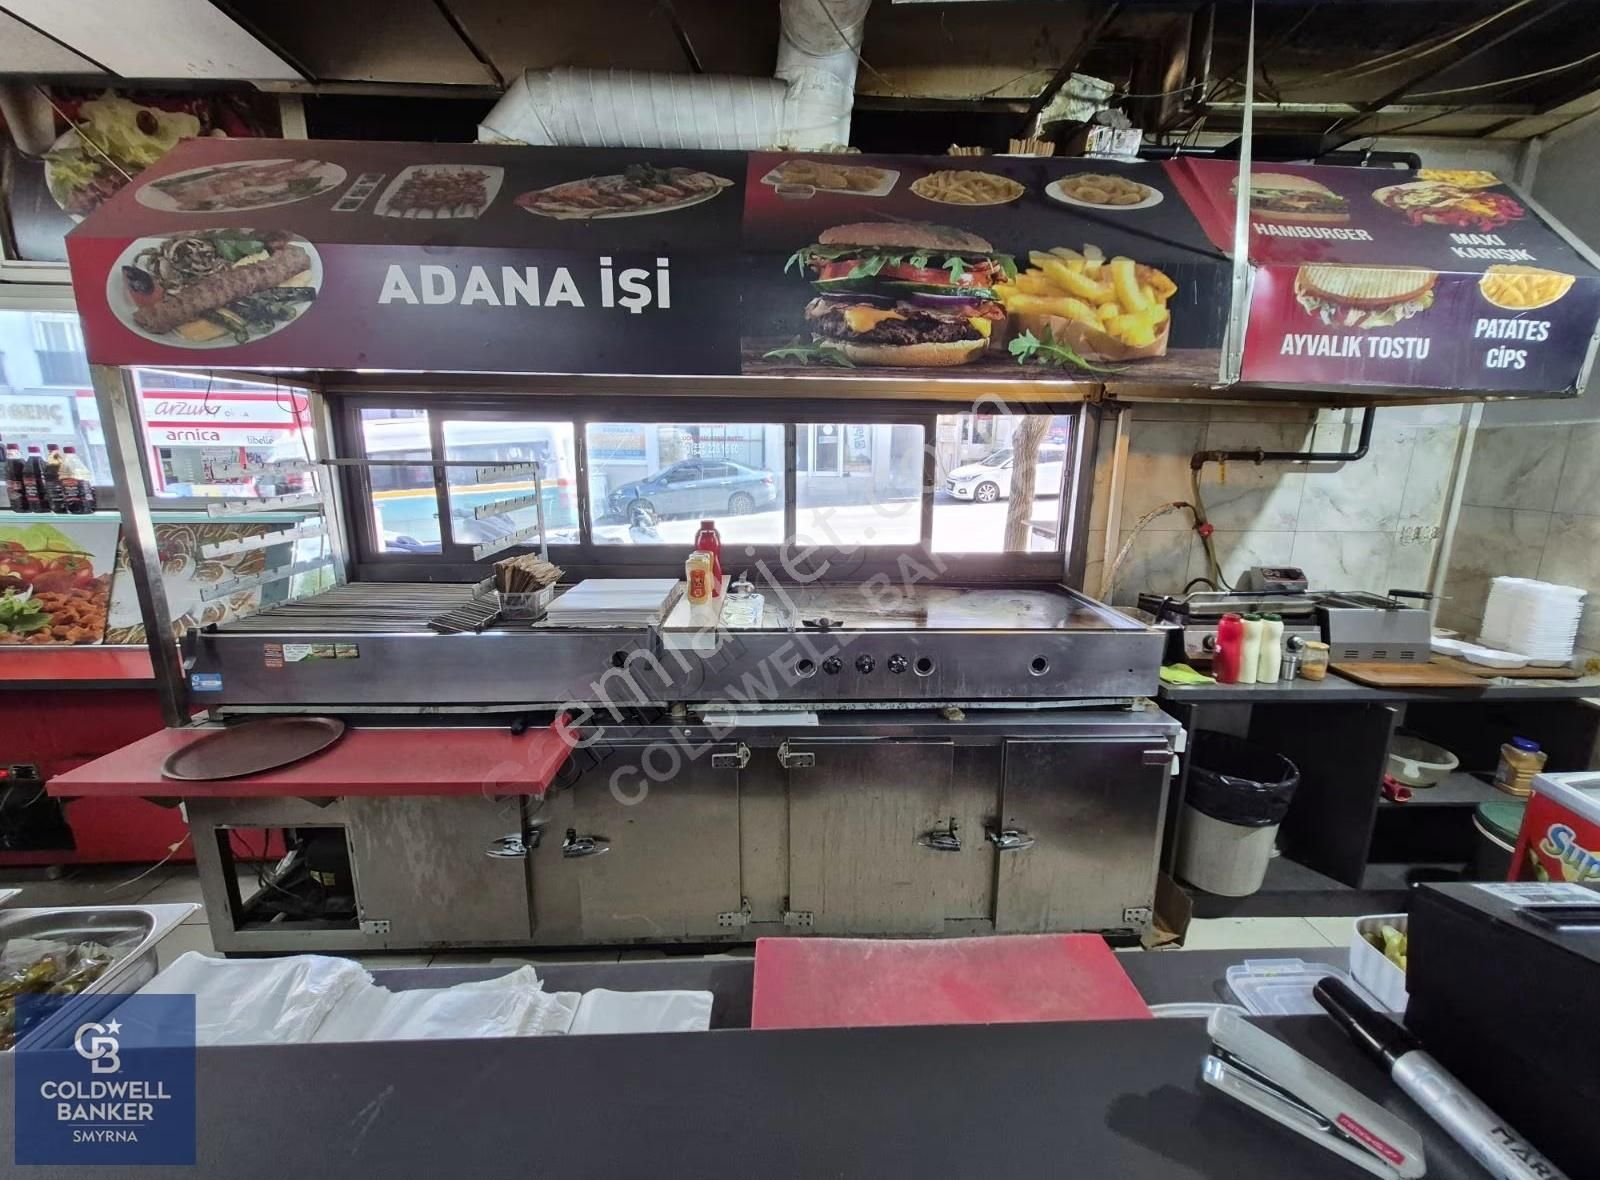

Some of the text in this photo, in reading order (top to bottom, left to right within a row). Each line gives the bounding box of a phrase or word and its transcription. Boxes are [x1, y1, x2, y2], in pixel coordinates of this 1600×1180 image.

[1252, 222, 1374, 241] HAMBURGER
[1449, 233, 1507, 246] MAXI
[1450, 246, 1538, 262] KARIŞIK
[378, 256, 670, 314] ADANA İŞİ
[1474, 318, 1552, 342] PATATES
[1280, 333, 1431, 360] AYVALIK TOSTU
[1486, 345, 1528, 370] CİPS
[166, 428, 220, 442] arnica
